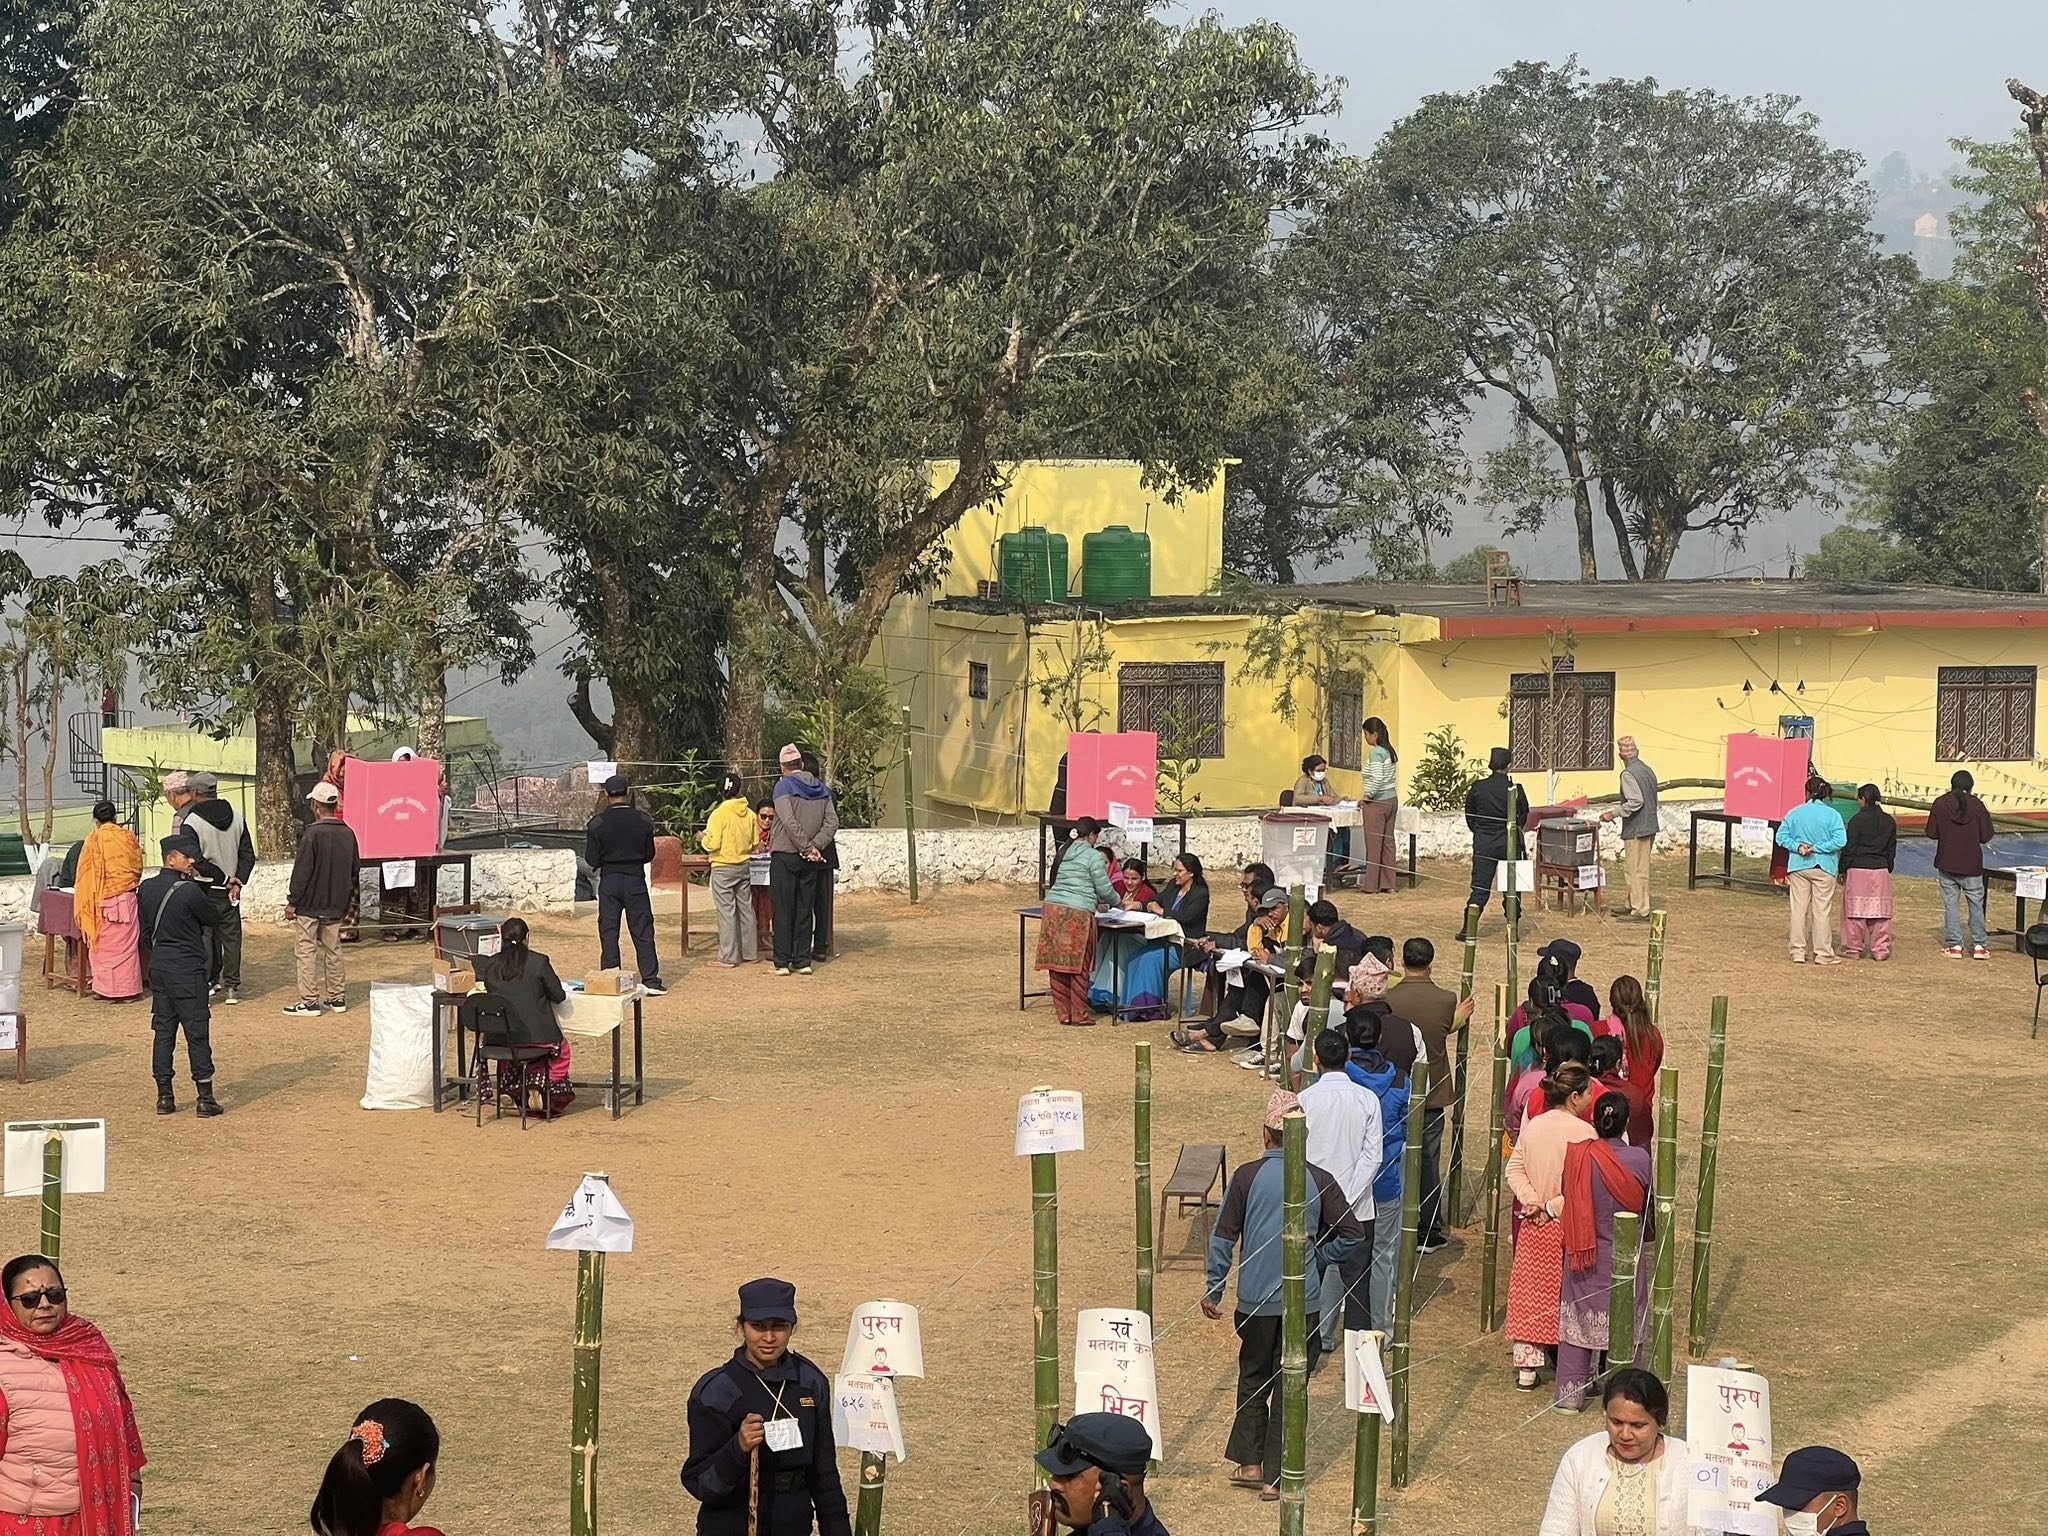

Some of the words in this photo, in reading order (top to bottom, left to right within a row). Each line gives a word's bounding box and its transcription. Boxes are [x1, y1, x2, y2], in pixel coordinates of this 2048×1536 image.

[861, 1316, 902, 1340] पुरुष
[1087, 1339, 1128, 1352] मतदान
[847, 1380, 874, 1392] मतदाता
[1718, 1385, 1761, 1413] पुरुष
[1704, 1453, 1734, 1466] मतदाता
[1730, 1475, 1749, 1489] देखि
[1728, 1499, 1752, 1512] सम्म
